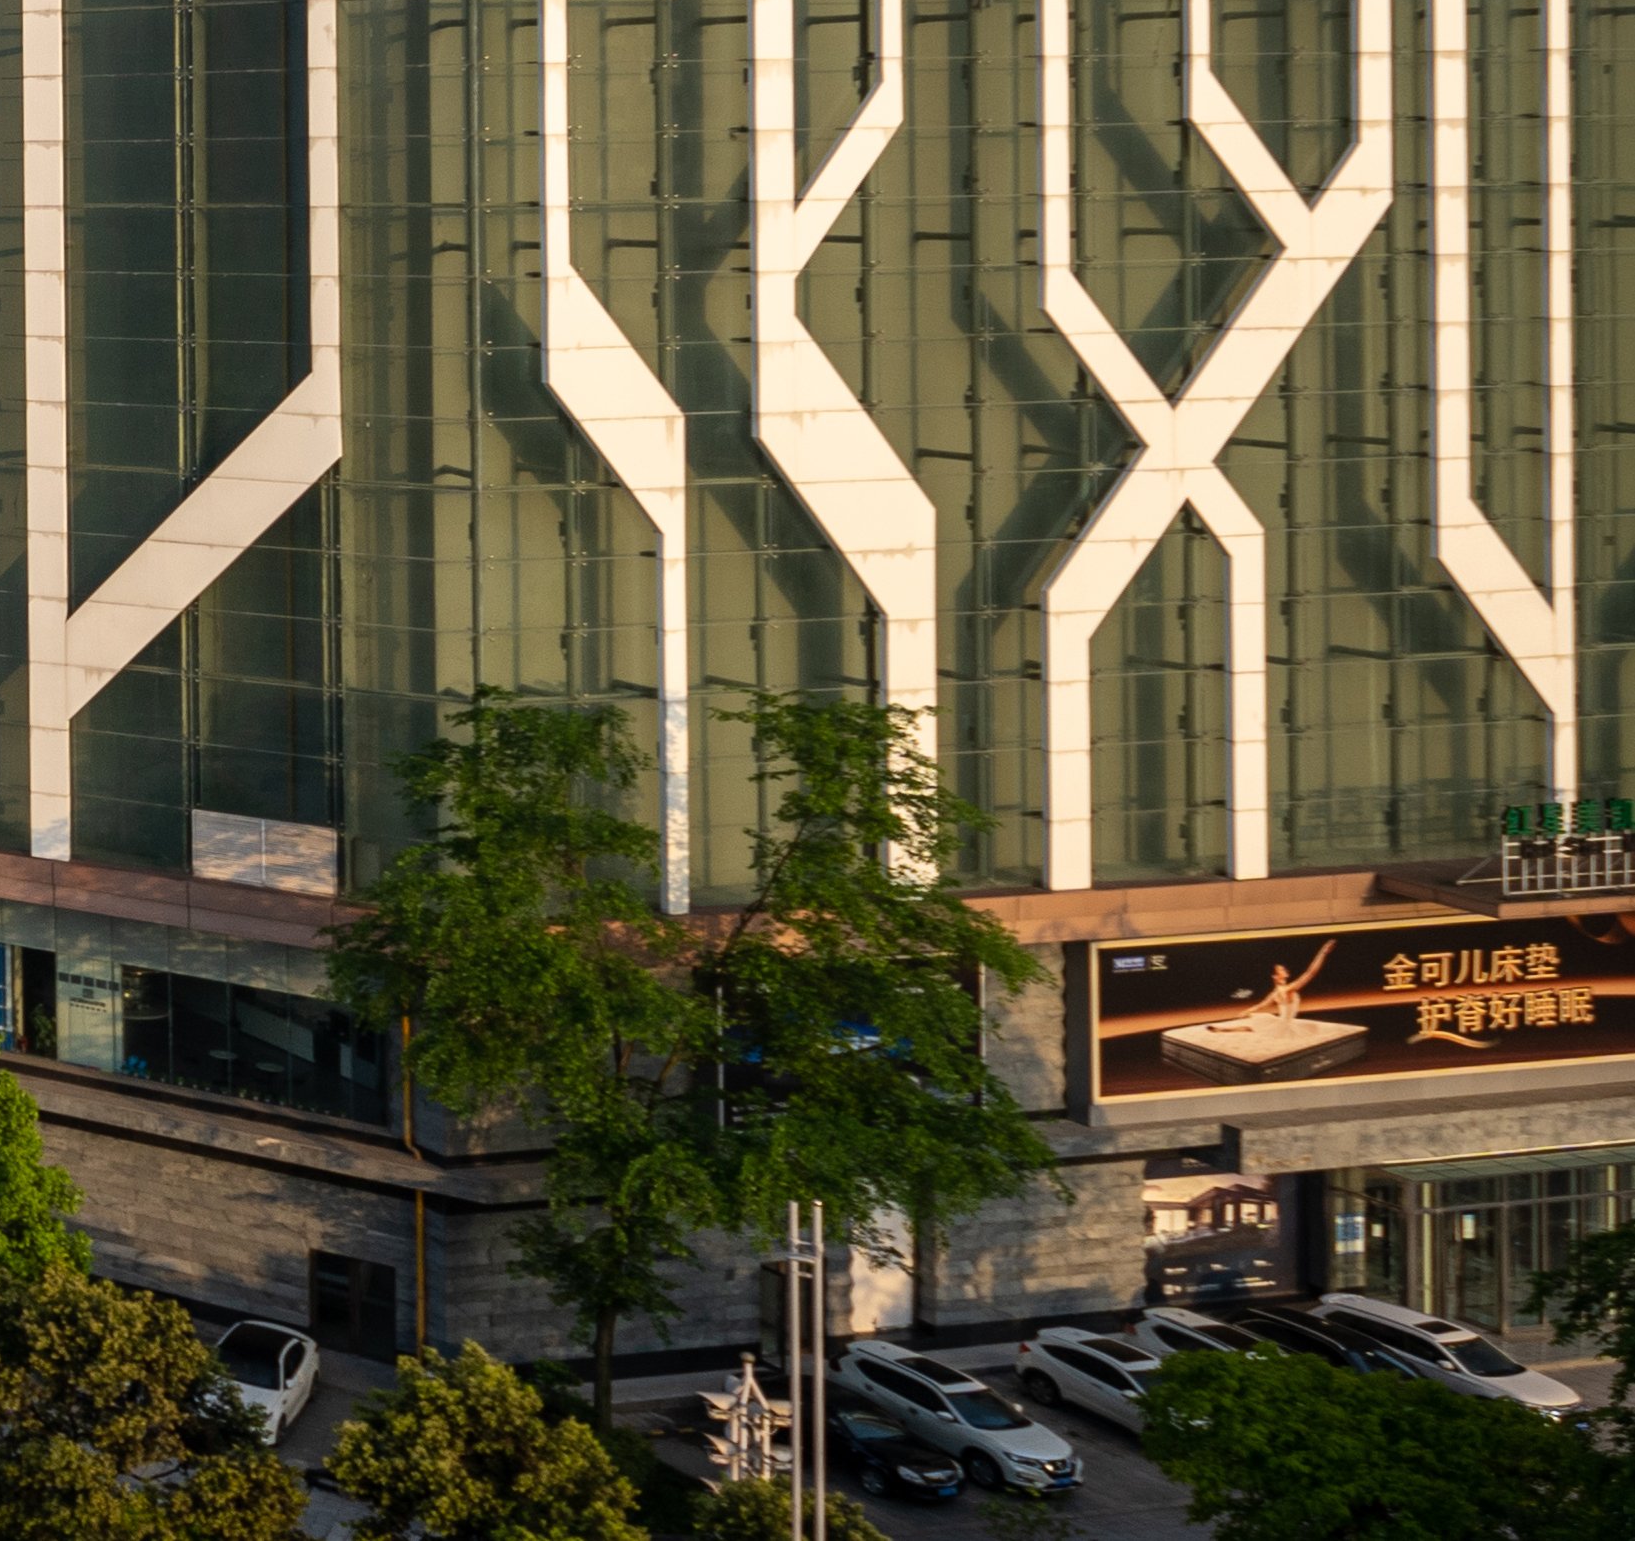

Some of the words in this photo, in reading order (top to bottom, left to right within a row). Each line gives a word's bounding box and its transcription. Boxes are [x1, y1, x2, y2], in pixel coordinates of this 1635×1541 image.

[1382, 942, 1561, 991] 金可儿床垫
[1416, 987, 1595, 1035] 护脊好睡眠
